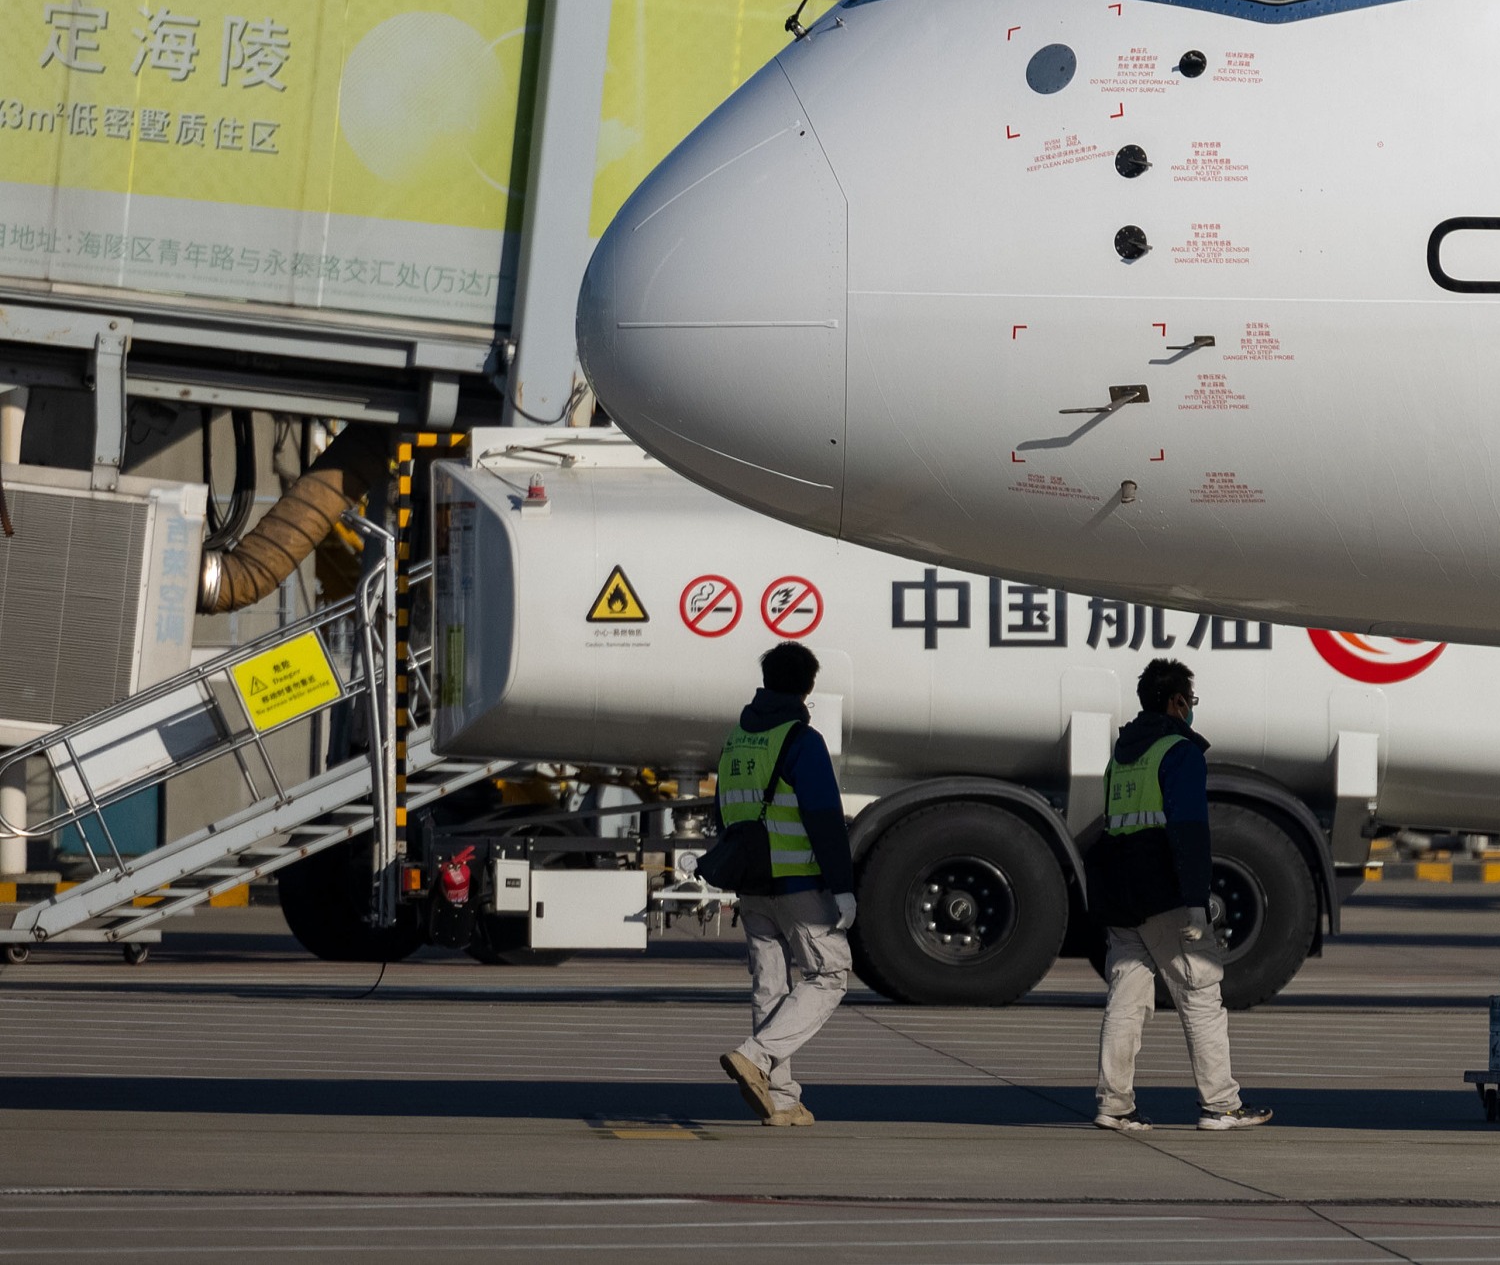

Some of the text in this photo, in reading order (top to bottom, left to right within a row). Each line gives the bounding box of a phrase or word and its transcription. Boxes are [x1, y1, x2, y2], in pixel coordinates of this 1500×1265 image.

[40, 0, 292, 92] 定海陵
[1042, 161, 1061, 169] CLEAN
[1075, 150, 1115, 162] SMOOTHNESS
